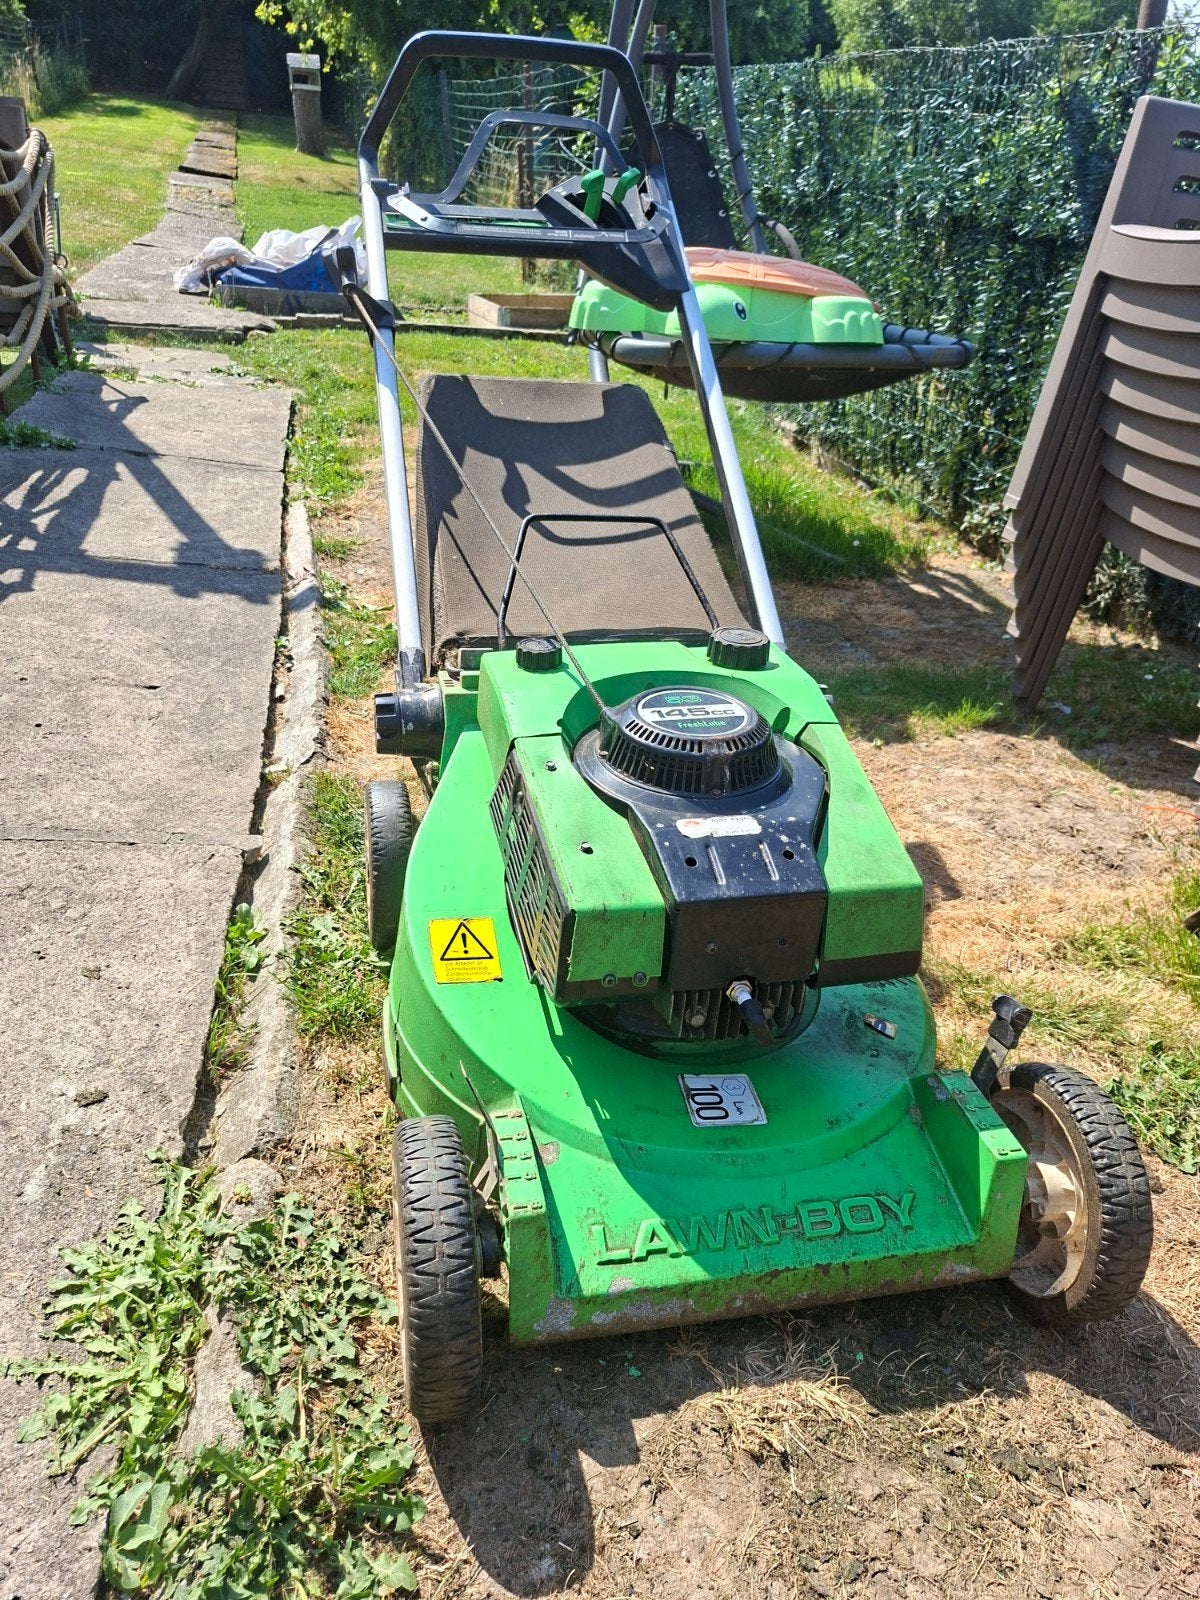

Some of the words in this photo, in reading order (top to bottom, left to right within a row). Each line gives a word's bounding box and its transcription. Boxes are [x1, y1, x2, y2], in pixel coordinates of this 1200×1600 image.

[677, 720, 727, 729] FreshLube
[690, 1084, 730, 1120] 100
[592, 1191, 914, 1266] LAWN-BOY
